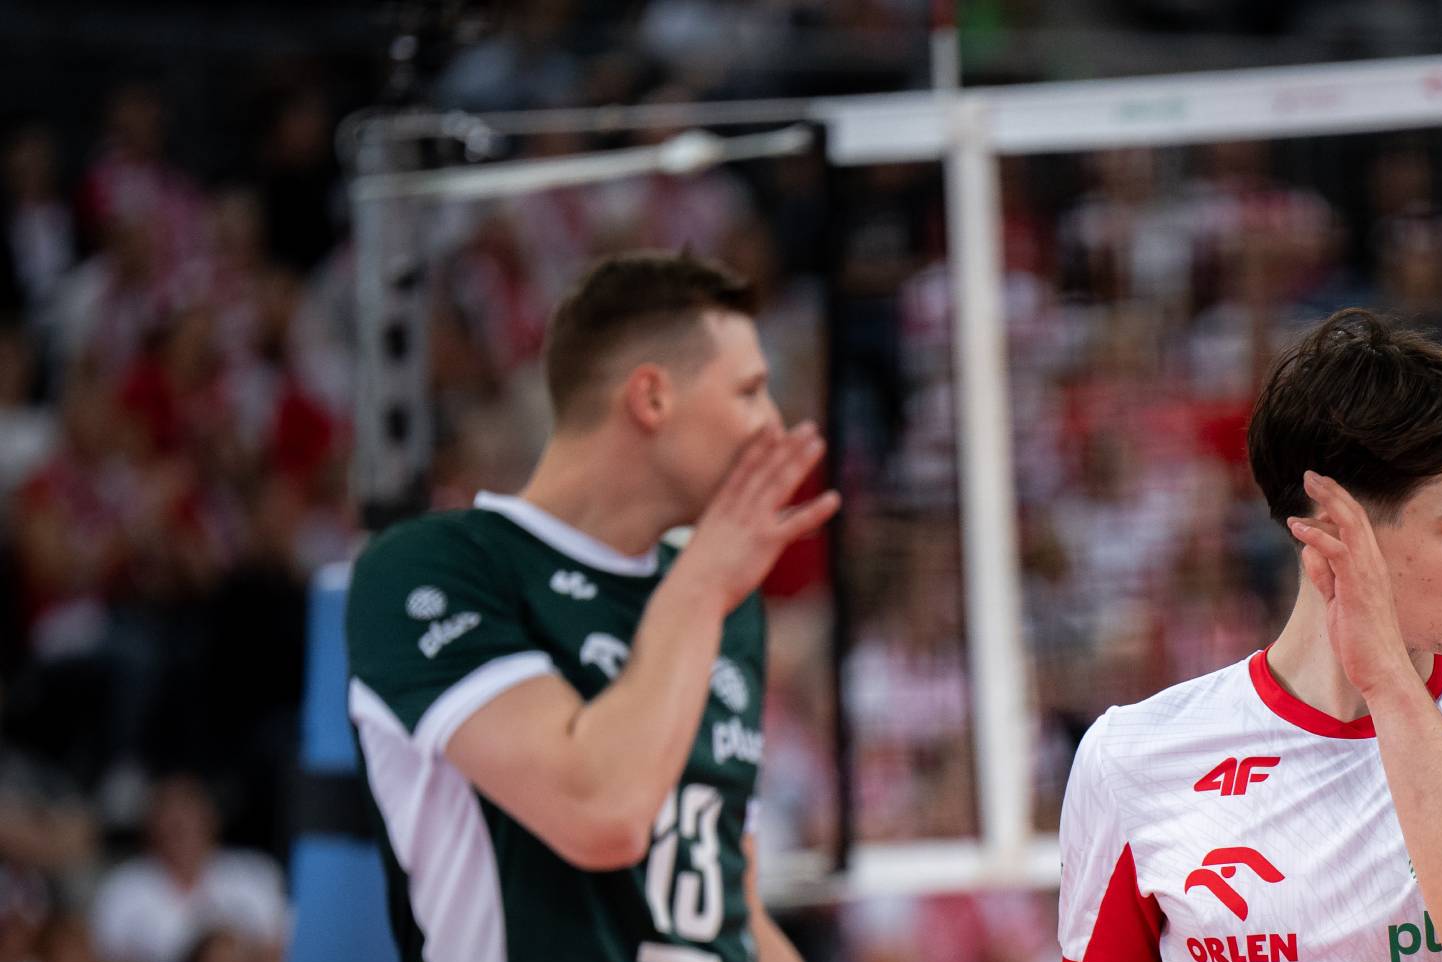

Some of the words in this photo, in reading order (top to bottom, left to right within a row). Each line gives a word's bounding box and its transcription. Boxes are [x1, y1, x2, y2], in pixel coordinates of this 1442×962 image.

[418, 611, 481, 659] plus
[1194, 756, 1281, 797] 4F
[644, 782, 724, 942] 13
